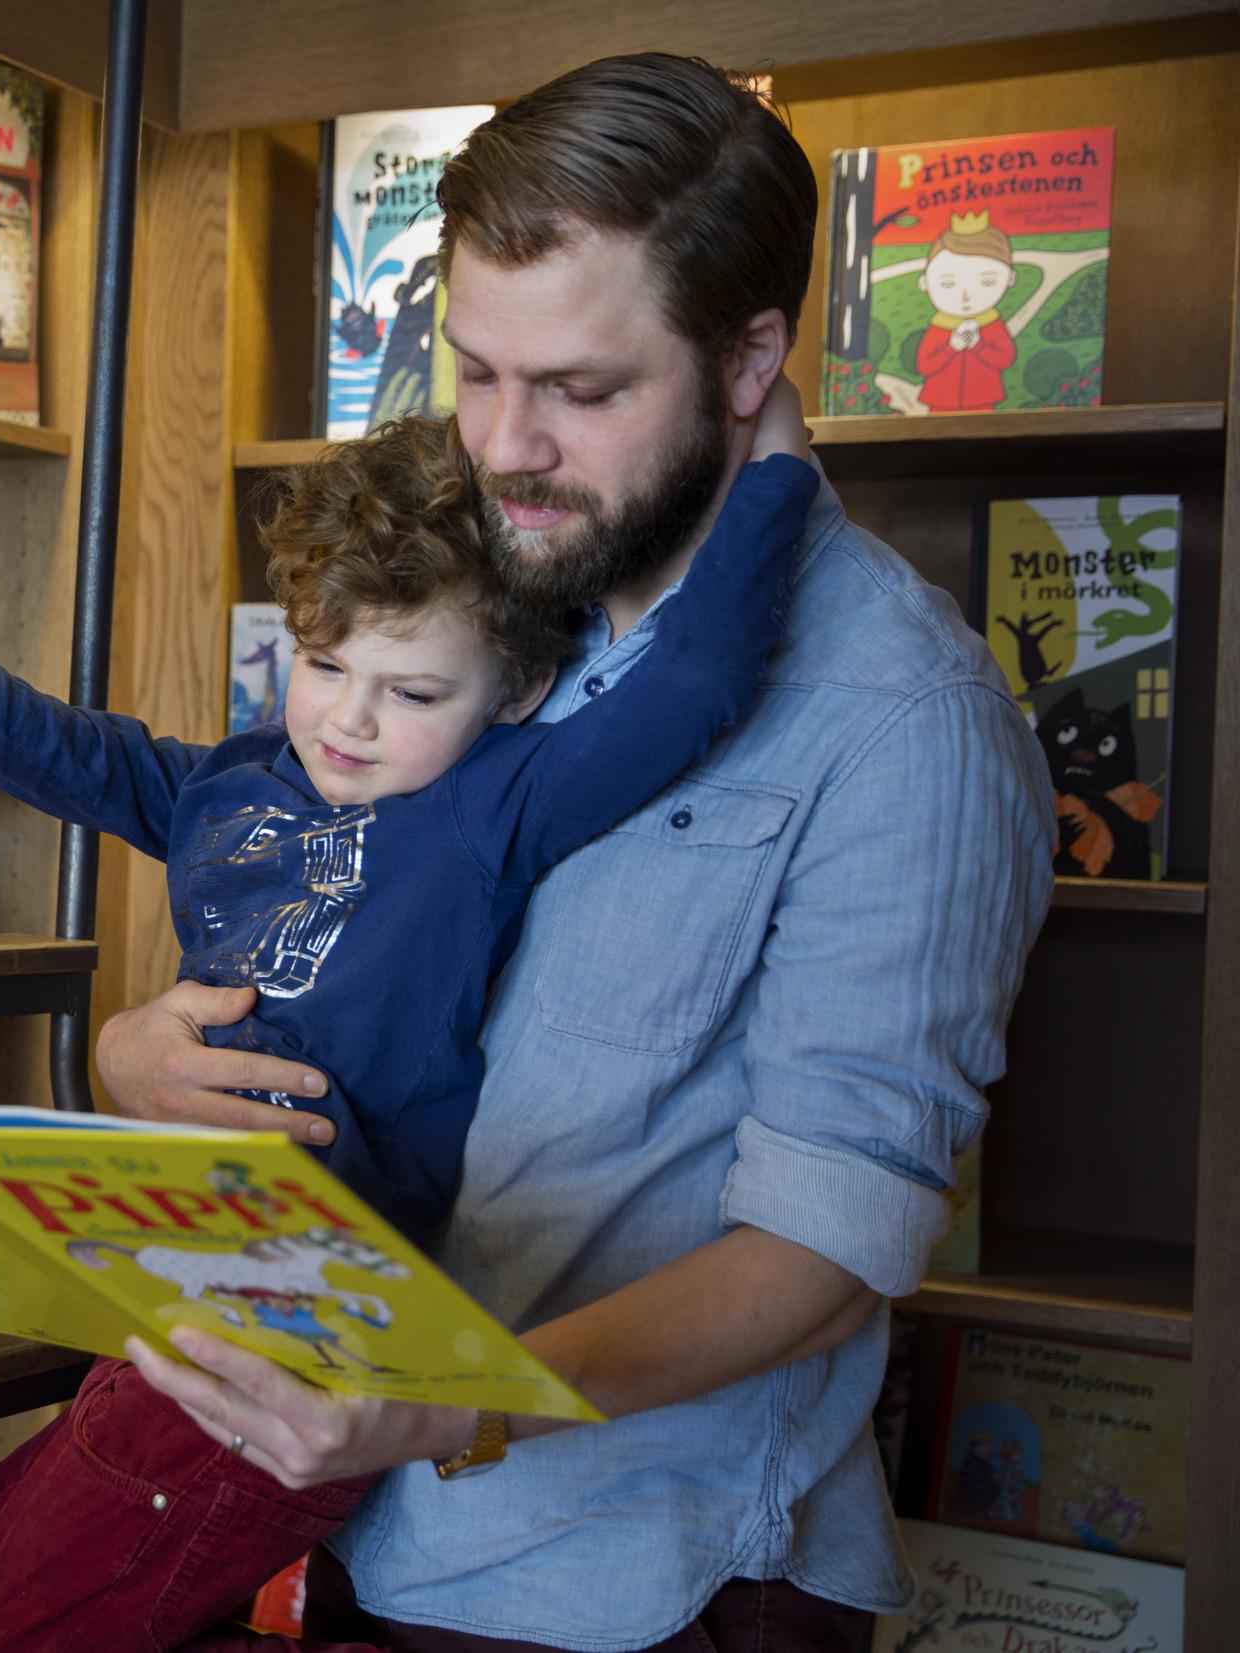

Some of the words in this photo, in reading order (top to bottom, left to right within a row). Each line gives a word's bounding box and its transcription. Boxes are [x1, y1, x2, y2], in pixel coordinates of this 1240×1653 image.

[896, 148, 1039, 190] Prinsen
[1050, 141, 1099, 167] och
[915, 173, 1084, 211] önskestenen
[1009, 549, 1159, 581] Monster
[1019, 582, 1028, 602] i
[1036, 579, 1145, 602] mörkret
[1028, 1342, 1082, 1366] Peter
[1010, 1361, 1155, 1400] Teddybjörnen
[963, 1572, 1107, 1627] Prinsessor
